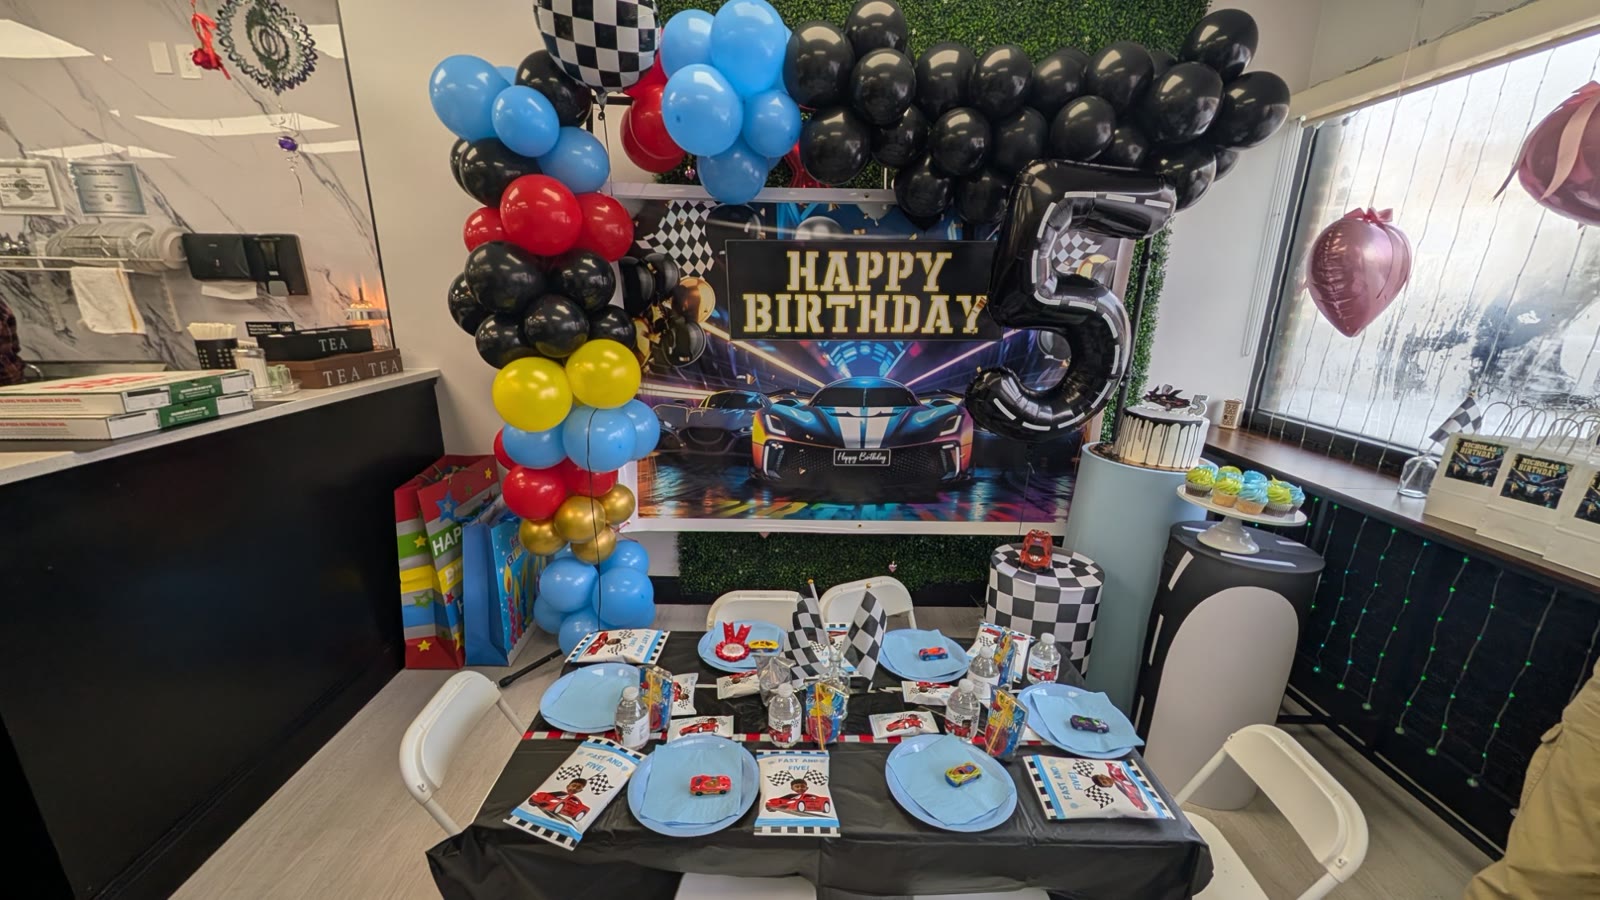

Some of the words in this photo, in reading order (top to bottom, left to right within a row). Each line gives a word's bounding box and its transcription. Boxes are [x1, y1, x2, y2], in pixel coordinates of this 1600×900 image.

[786, 250, 953, 292] HAPPY
[742, 293, 988, 335] BIRTHDAY
[318, 337, 348, 352] TEA
[322, 366, 361, 386] TEA
[368, 359, 399, 377] TEA
[1460, 447, 1496, 459] BIRTHDAY
[1463, 441, 1497, 453] NICHOLAS
[837, 452, 858, 464] Happy
[859, 452, 887, 464] Birthday
[1521, 457, 1559, 470] NICHOLAS
[1518, 463, 1557, 478] BIRTHDAY
[432, 523, 465, 556] HAP
[585, 761, 607, 772] FIVE!
[586, 752, 607, 760] FAST
[607, 756, 623, 768] AND
[1050, 766, 1063, 779] AND
[1067, 771, 1083, 791] FIVE!
[1057, 782, 1072, 800] FAST
